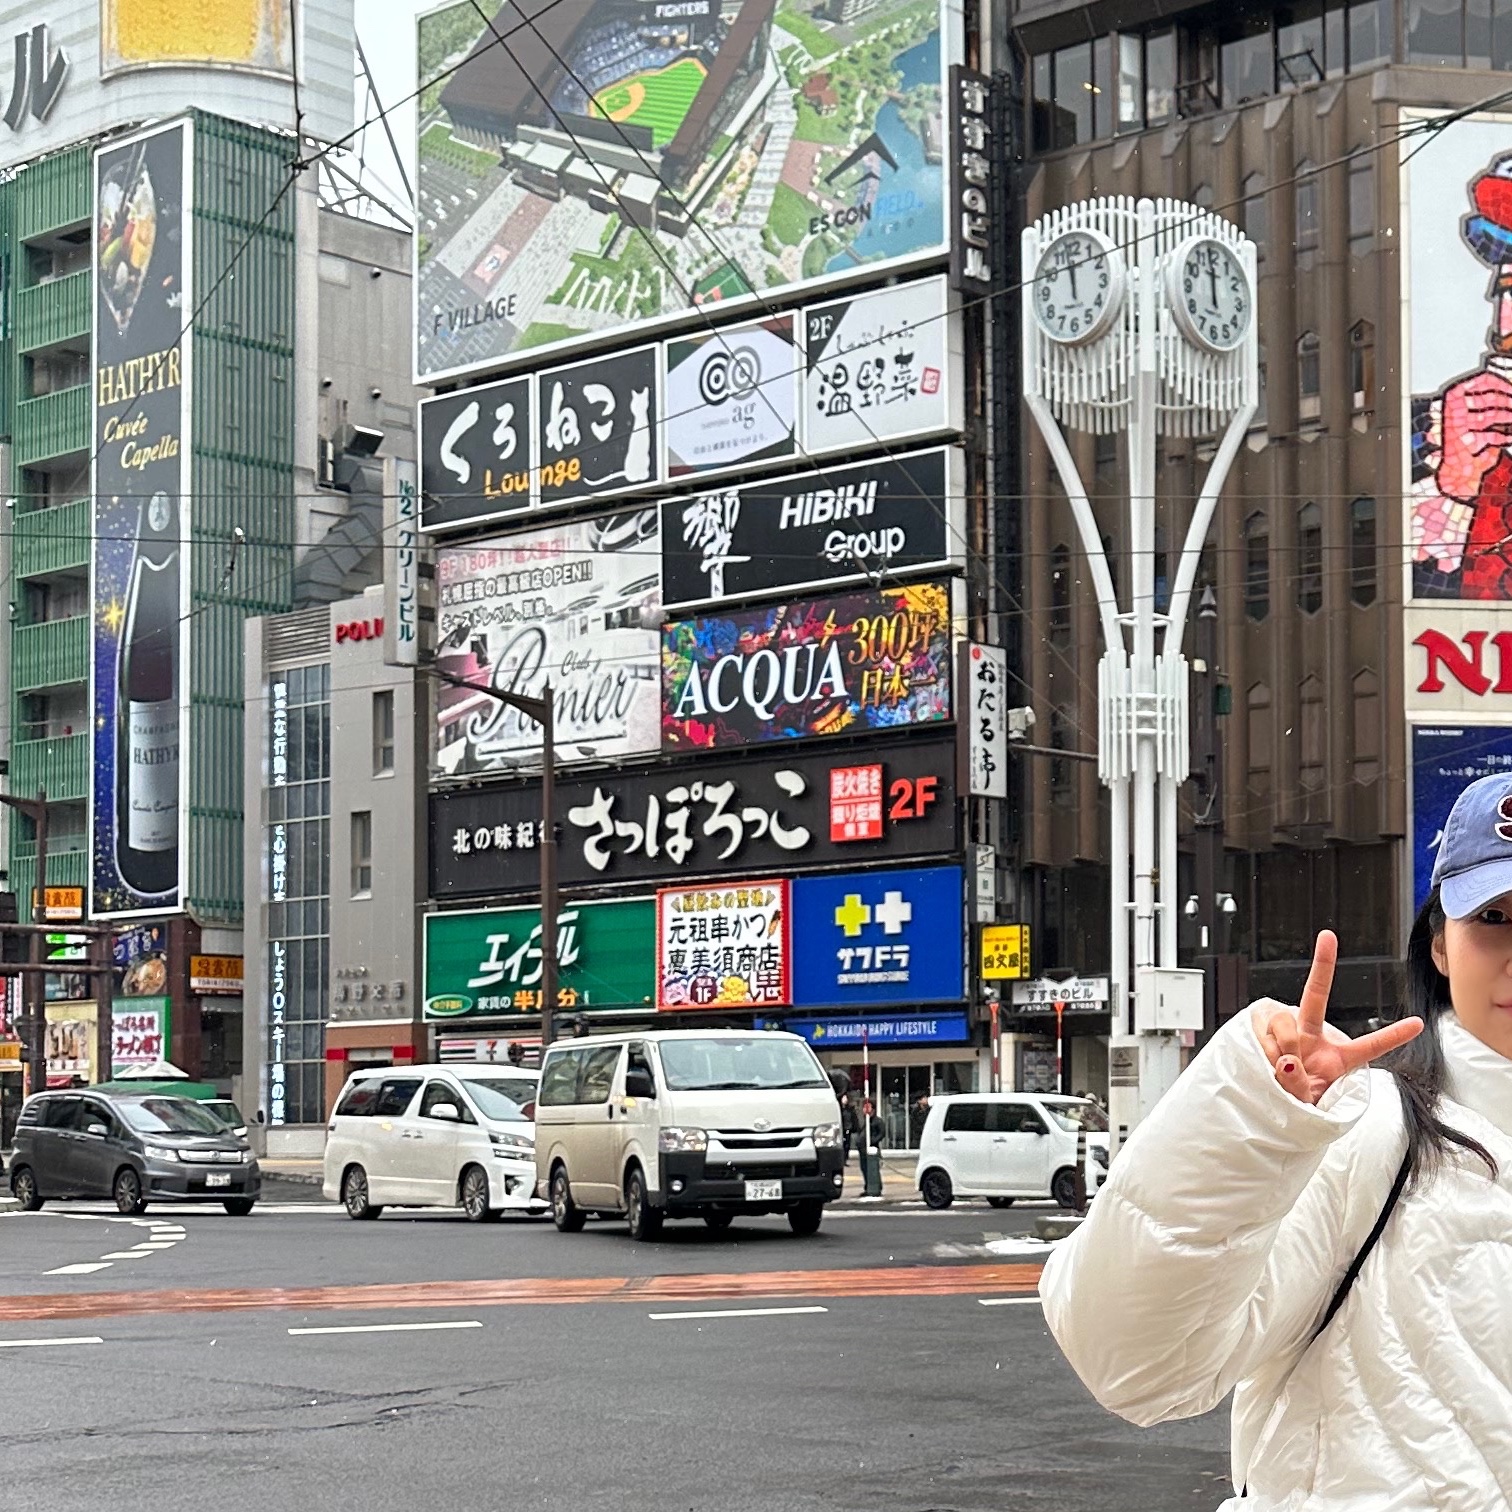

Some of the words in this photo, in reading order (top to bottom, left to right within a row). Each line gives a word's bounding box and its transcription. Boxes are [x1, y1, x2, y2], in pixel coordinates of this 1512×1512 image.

[3, 23, 71, 131] ル
[433, 313, 444, 337] F
[448, 293, 517, 332] VILLAGE
[809, 315, 834, 342] 2F
[98, 348, 182, 404] HATHYR
[104, 411, 148, 443] Cuvée
[121, 440, 179, 471] Capella
[484, 457, 582, 498] Lounge
[779, 480, 878, 530] HIBIKI
[824, 526, 906, 563] Group
[673, 640, 848, 721] ACQUA
[860, 668, 938, 711] 日本一
[889, 775, 938, 821] 2F
[568, 768, 811, 871] さっぽろっこ
[667, 912, 767, 945] 元祖串かつ
[667, 943, 780, 975] 恵美須商店
[696, 986, 712, 1002] 1F
[1026, 987, 1094, 1001] すすきのビル
[827, 1023, 868, 1037] HOKKAIDO
[868, 1023, 894, 1036] HAPPY
[895, 1020, 937, 1036] LIFESTYLE
